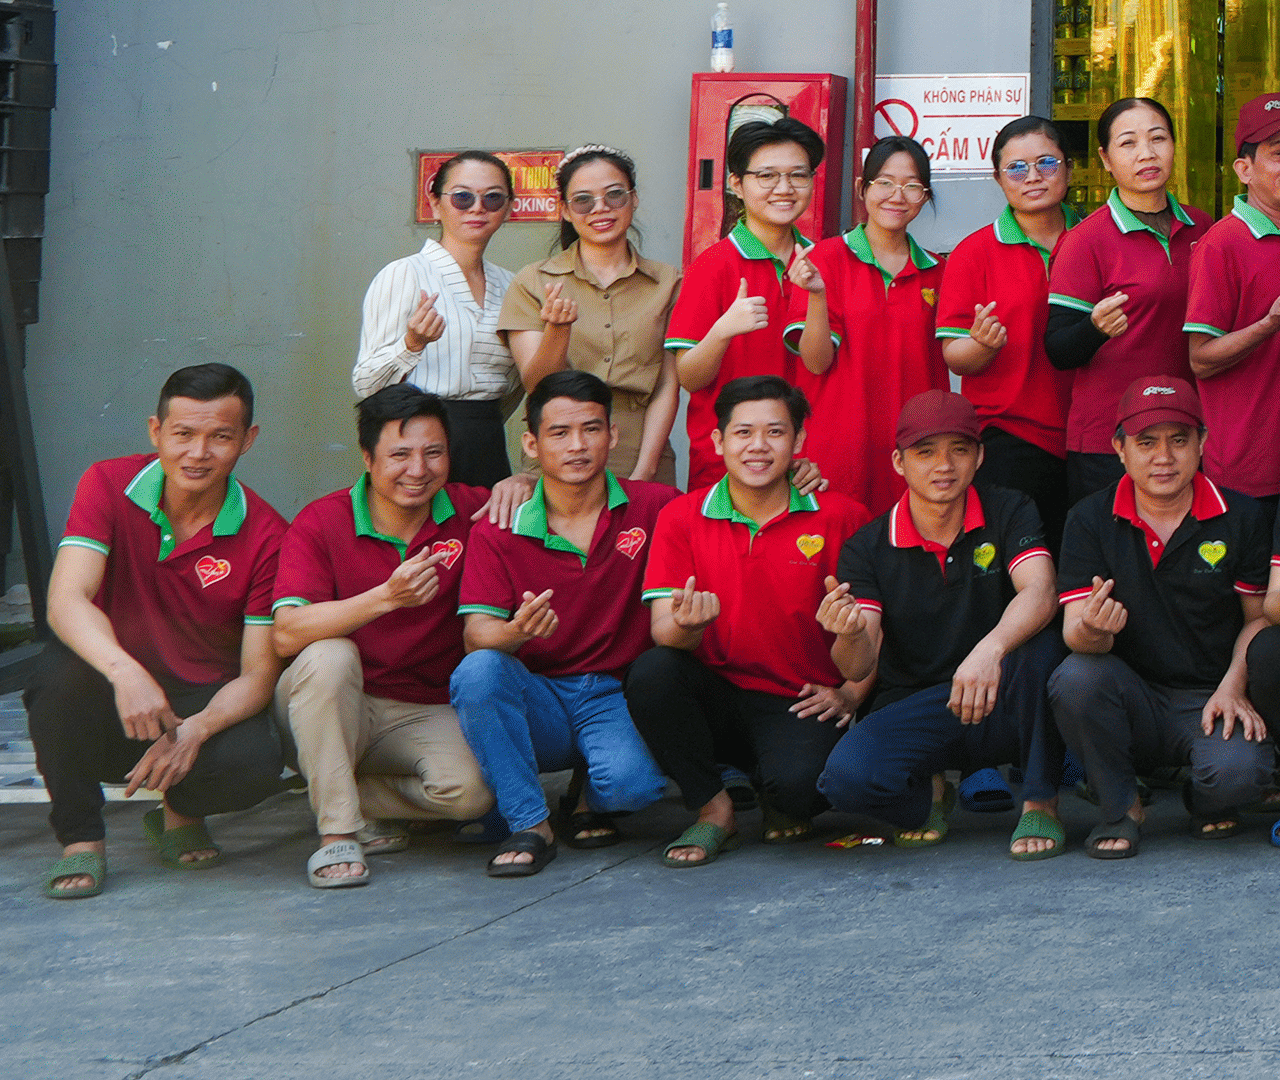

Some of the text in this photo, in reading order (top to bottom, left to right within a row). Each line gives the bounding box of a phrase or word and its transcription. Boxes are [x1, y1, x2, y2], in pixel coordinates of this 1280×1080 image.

[923, 86, 1022, 105] KHÔNG PHẬN SỰ
[922, 127, 969, 161] CẤM
[512, 197, 556, 212] OKING
